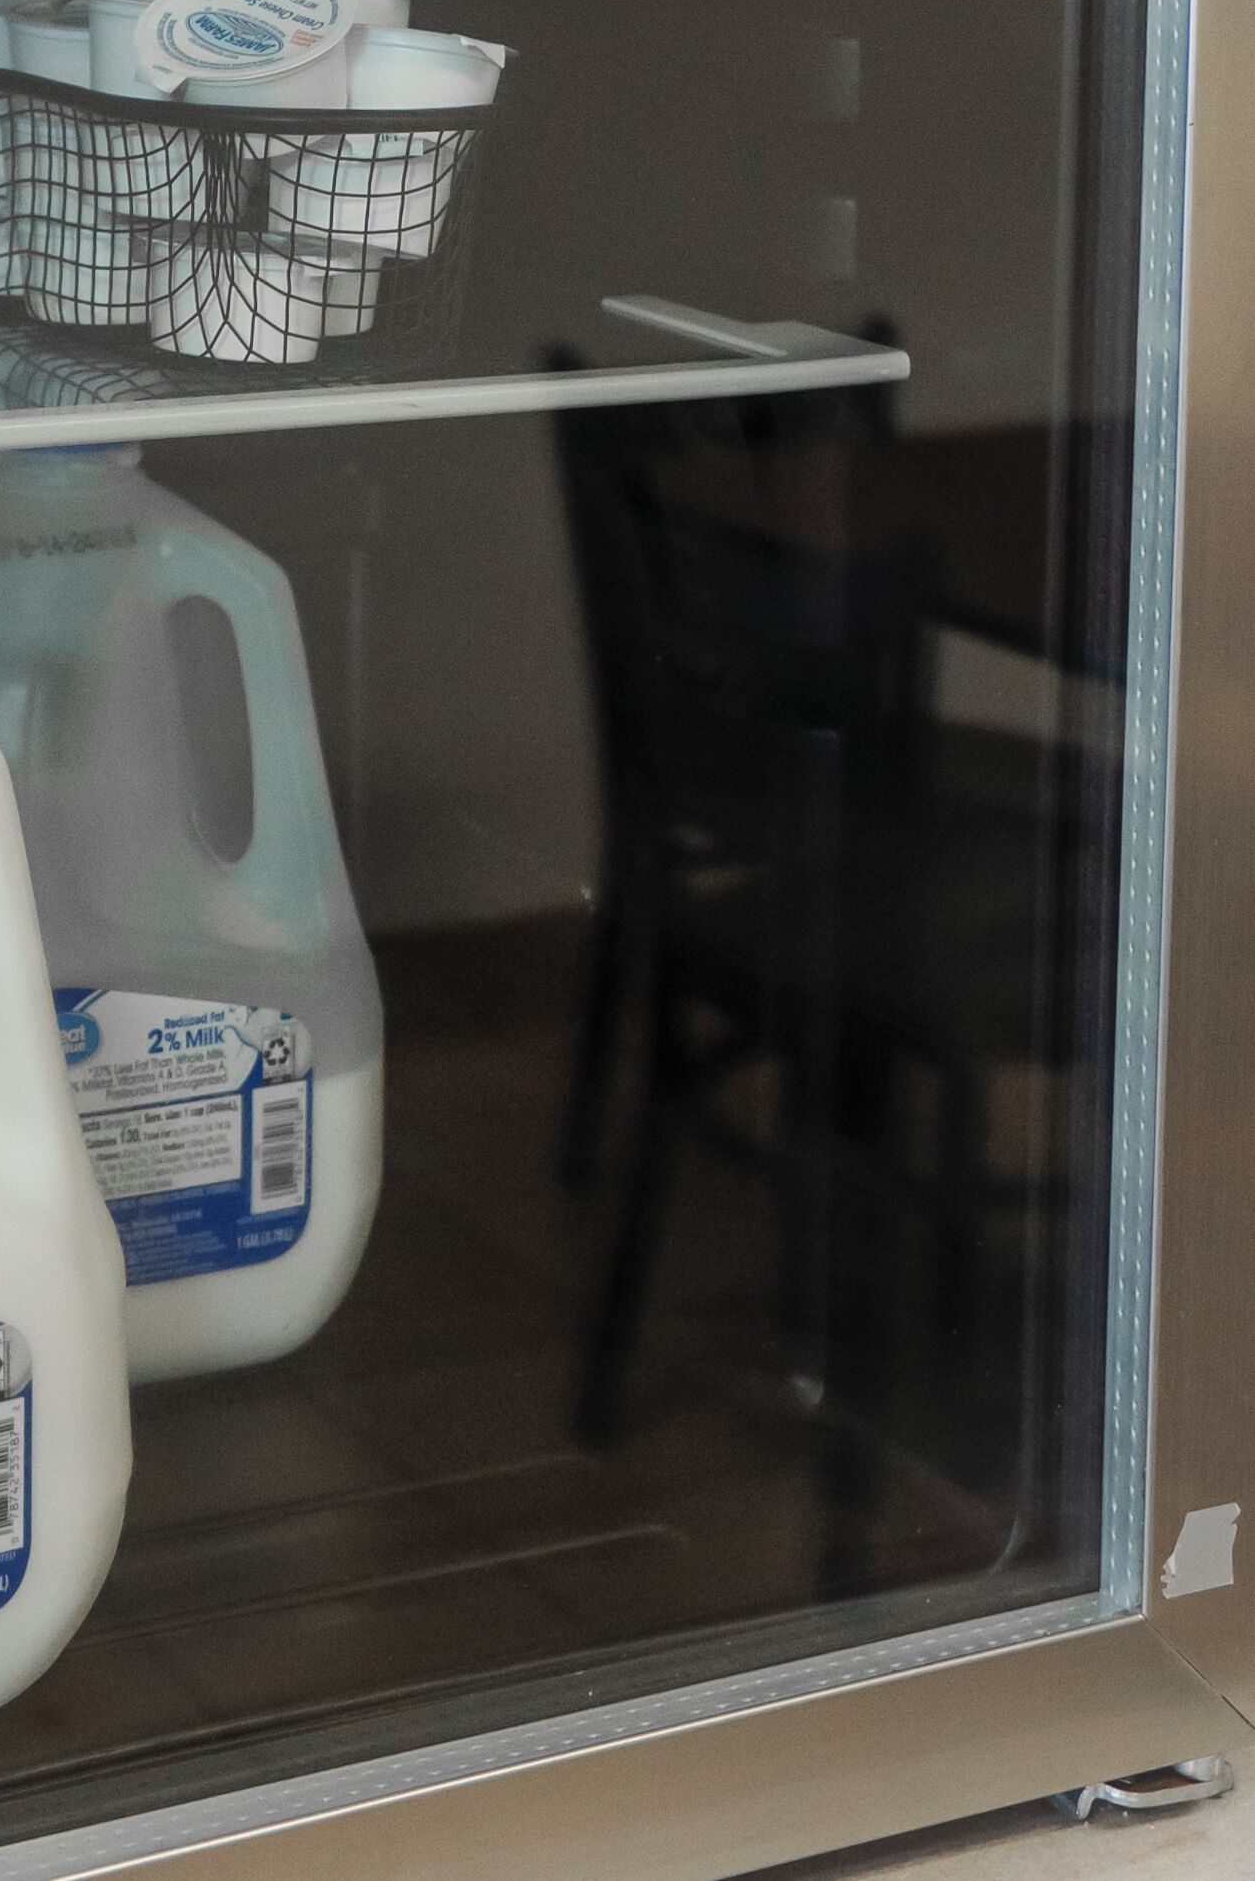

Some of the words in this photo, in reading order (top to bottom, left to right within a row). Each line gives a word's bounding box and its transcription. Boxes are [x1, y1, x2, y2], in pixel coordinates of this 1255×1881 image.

[194, 13, 232, 44] FARM
[292, 13, 325, 32] Cream
[224, 32, 277, 55] JAMES
[163, 1013, 208, 1030] Reduced
[209, 1009, 226, 1024] Fat
[147, 1027, 181, 1054] 2%
[185, 1025, 225, 1049] Milk
